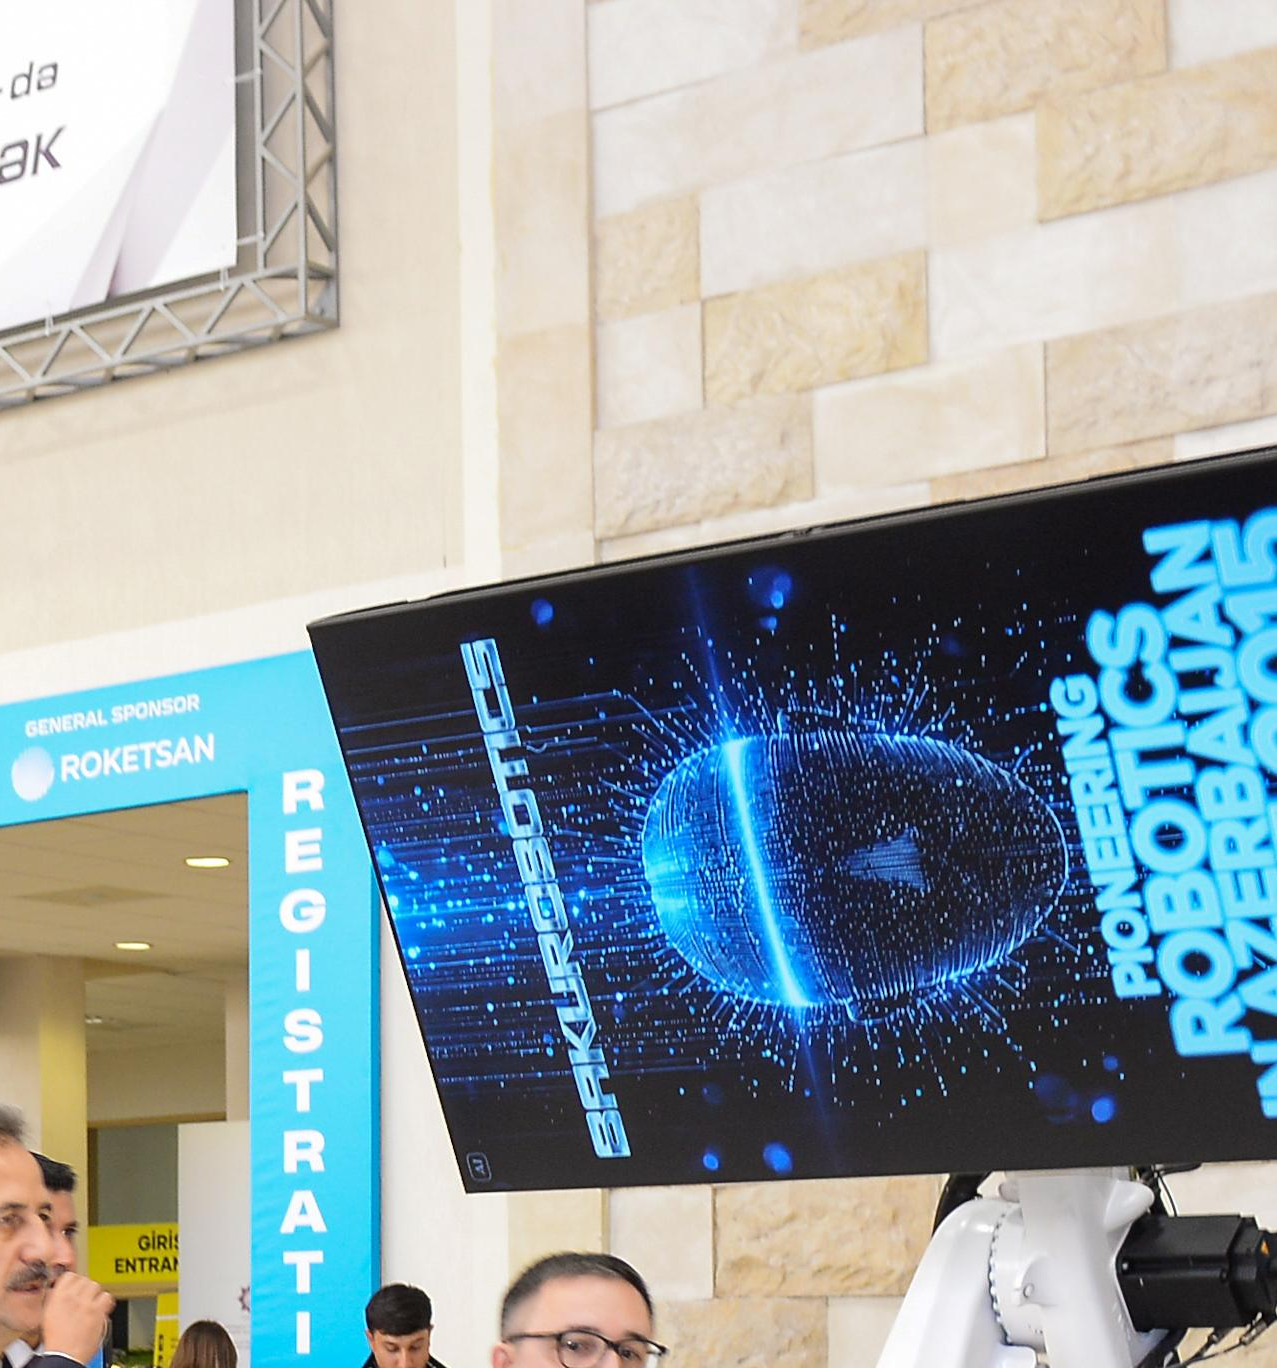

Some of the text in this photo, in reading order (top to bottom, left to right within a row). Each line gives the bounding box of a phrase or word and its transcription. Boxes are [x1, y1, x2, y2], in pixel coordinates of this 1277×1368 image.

[25, 693, 200, 738] GENERAL SPONSOR
[60, 733, 215, 783] ROKETSAN
[1049, 671, 1162, 1000] PIONEERING
[1085, 601, 1251, 1058] ROBOTICS
[459, 637, 633, 1160] BAKUROBOTICS
